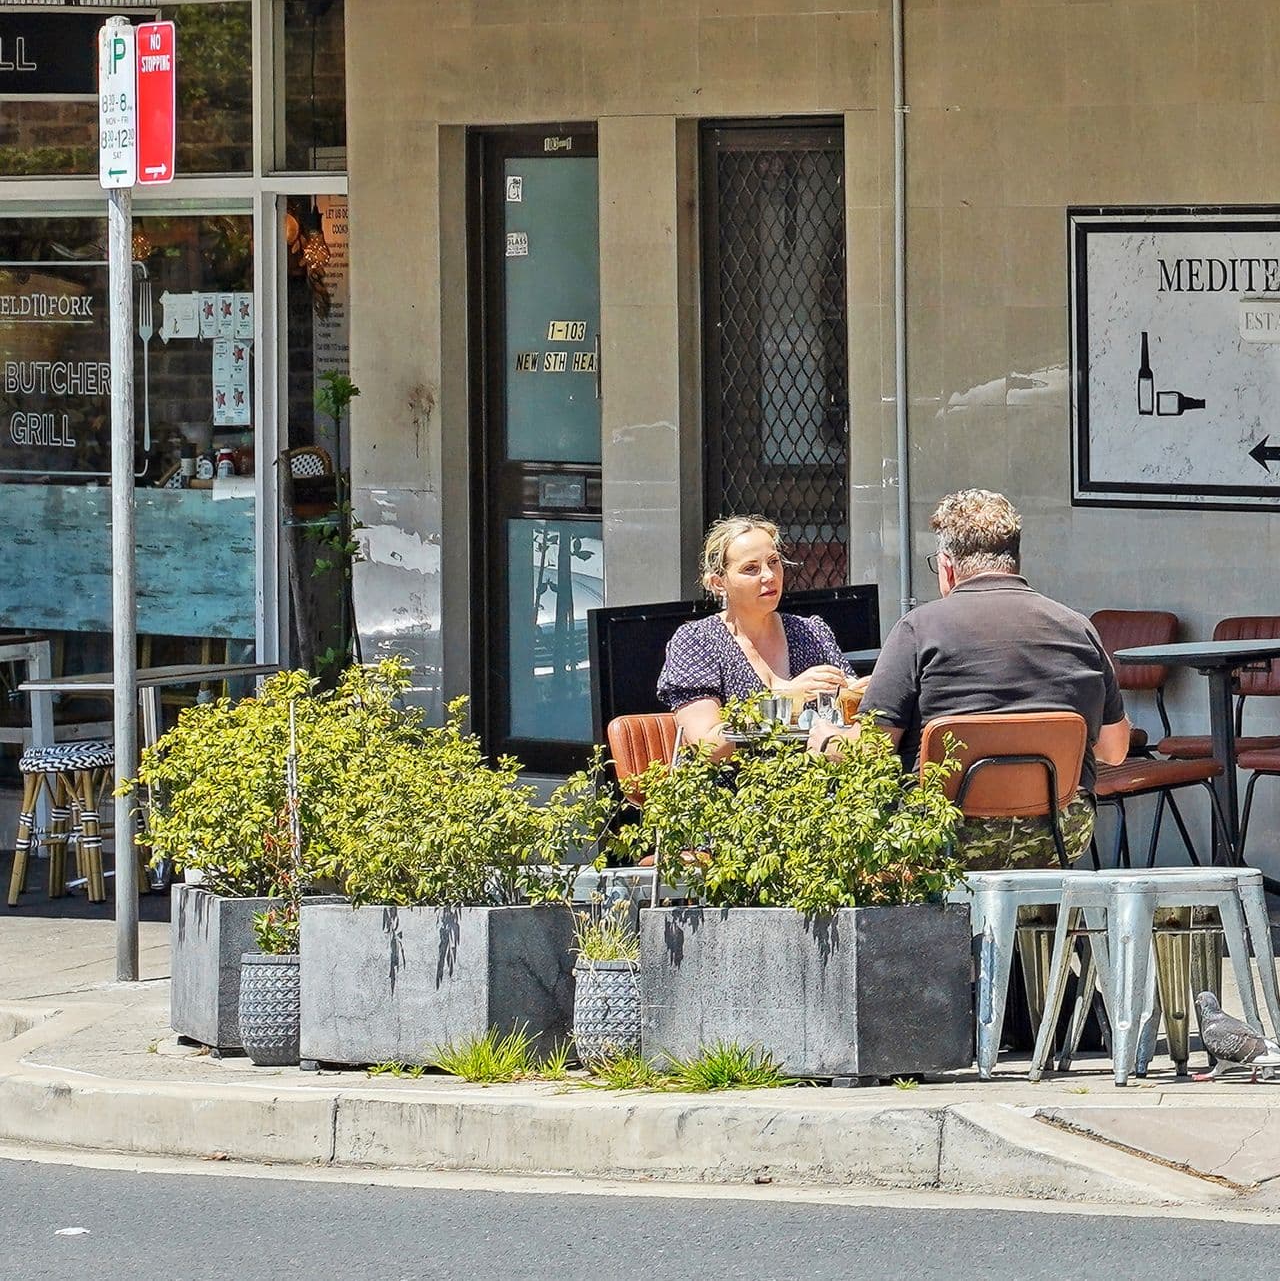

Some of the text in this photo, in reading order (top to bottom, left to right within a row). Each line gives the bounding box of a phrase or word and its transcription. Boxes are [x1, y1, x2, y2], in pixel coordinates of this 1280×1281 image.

[150, 34, 161, 50] NO
[141, 54, 171, 72] STOPPING
[112, 150, 122, 160] SAT
[550, 322, 585, 340] 1-103
[516, 352, 597, 371] NEW STH HEA
[5, 361, 111, 395] BUTCHER
[10, 411, 77, 448] GRILL
